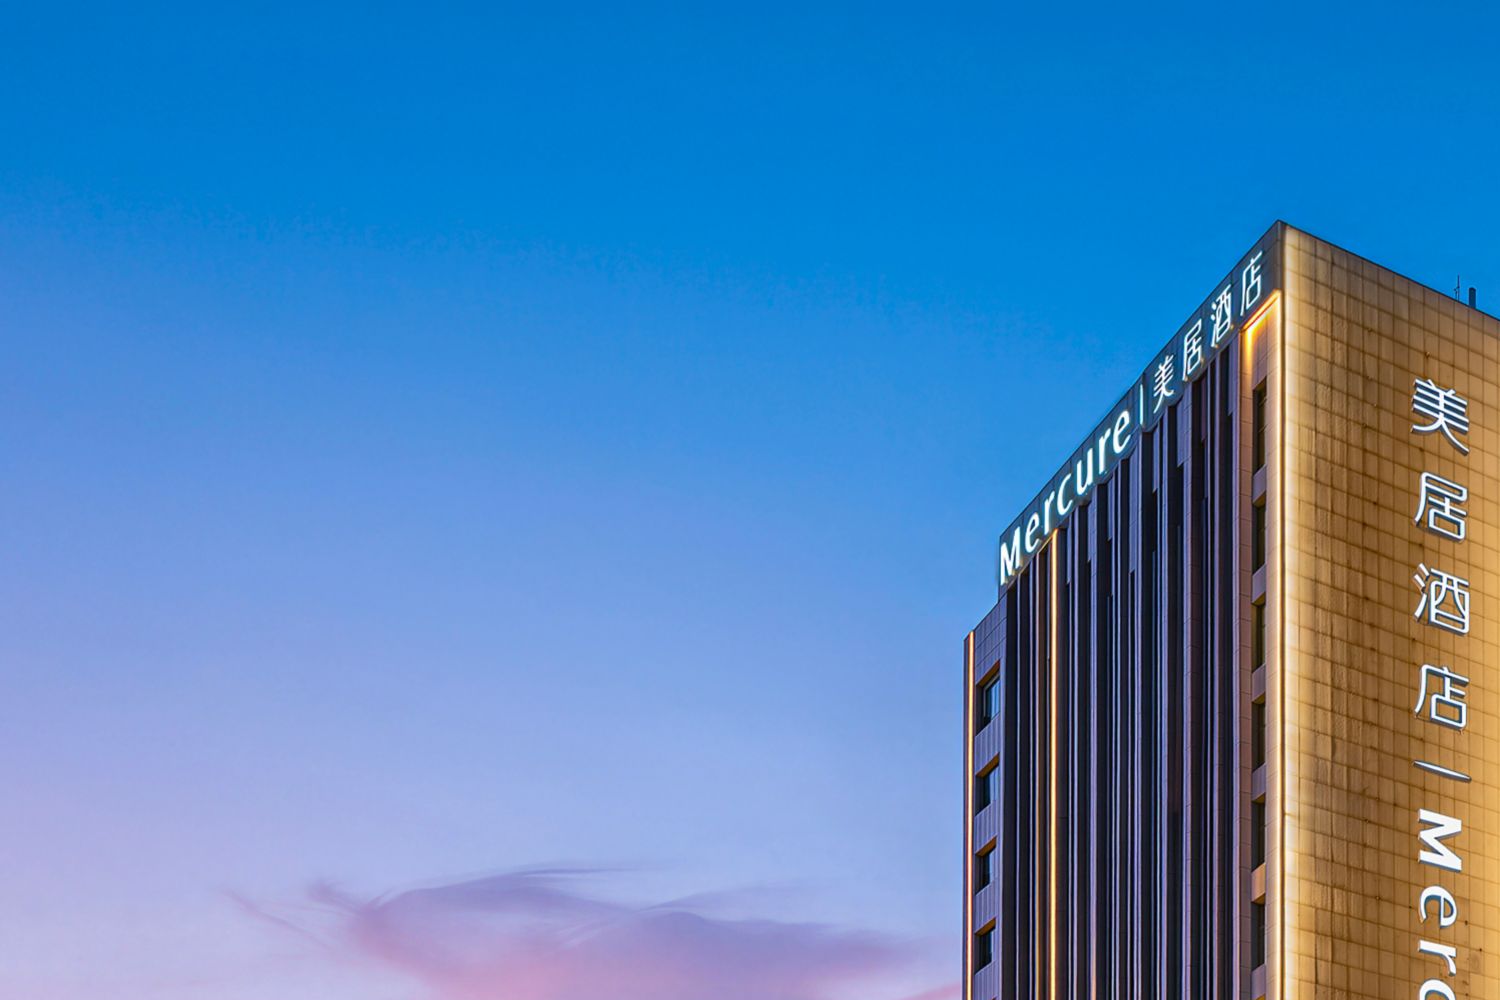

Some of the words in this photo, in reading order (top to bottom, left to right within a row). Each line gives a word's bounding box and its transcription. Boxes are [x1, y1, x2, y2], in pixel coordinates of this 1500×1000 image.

[1000, 410, 1130, 585] Mercure
[1153, 250, 1263, 413] 美居酒店
[1411, 378, 1470, 733] 美居酒店
